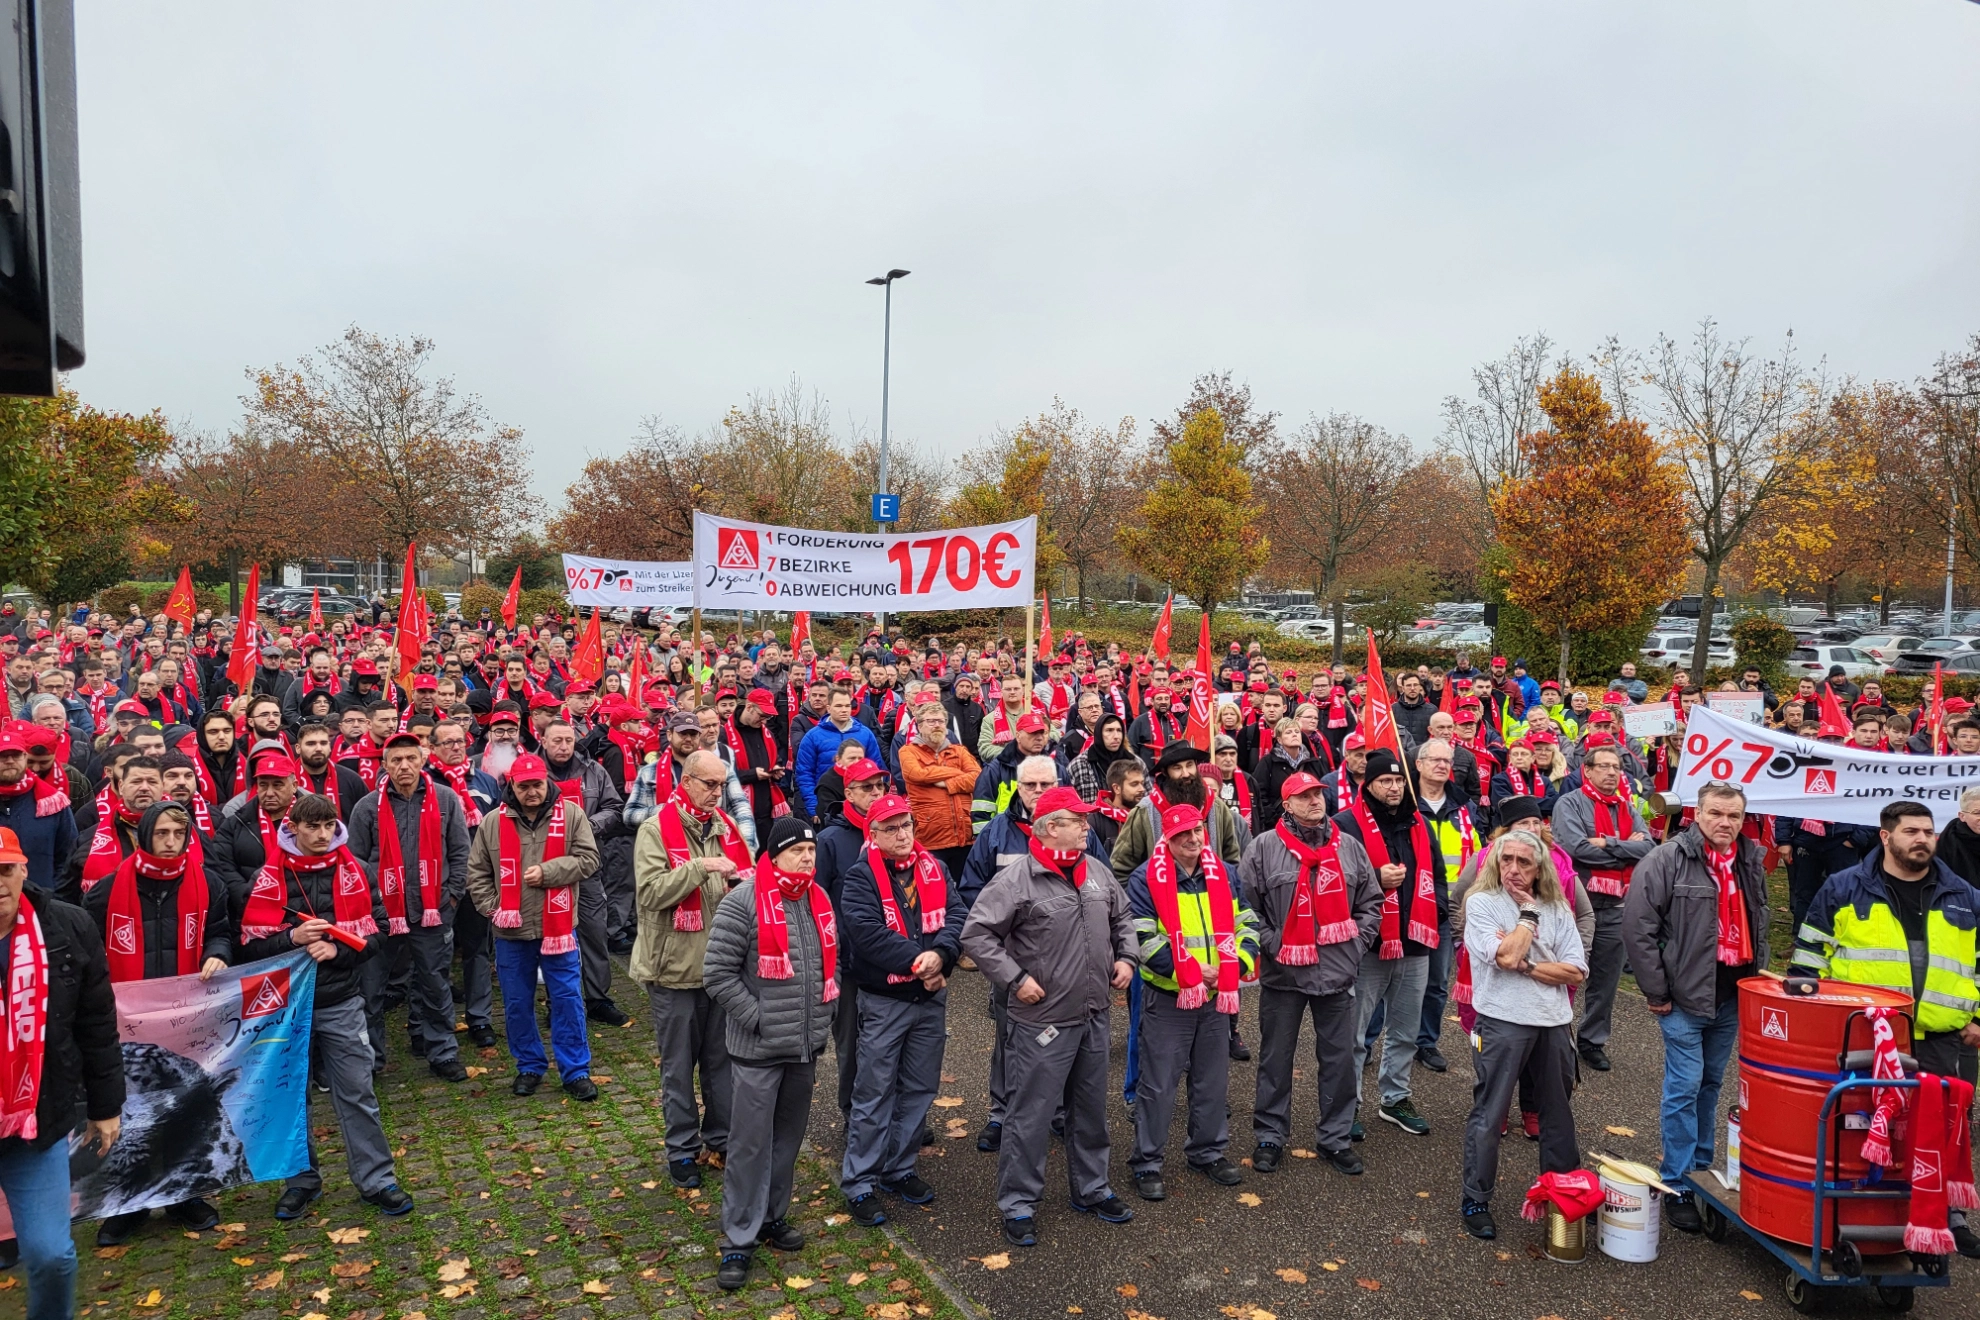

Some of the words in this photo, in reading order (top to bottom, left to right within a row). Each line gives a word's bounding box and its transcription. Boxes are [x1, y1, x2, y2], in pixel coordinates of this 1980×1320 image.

[880, 498, 891, 518] E
[765, 531, 772, 545] 1
[777, 533, 885, 548] FORDERUNG
[767, 556, 777, 572] 7
[780, 558, 852, 573] BEZIRKE
[887, 532, 1021, 594] 170€
[635, 571, 652, 579] Mit
[654, 570, 673, 579] der
[635, 585, 656, 593] zum
[765, 580, 777, 596] 0
[780, 583, 897, 596] ABWEICHUNG
[1846, 762, 1889, 774] Mit
[1843, 786, 1894, 798] zum
[12, 933, 37, 1042] MEHR
